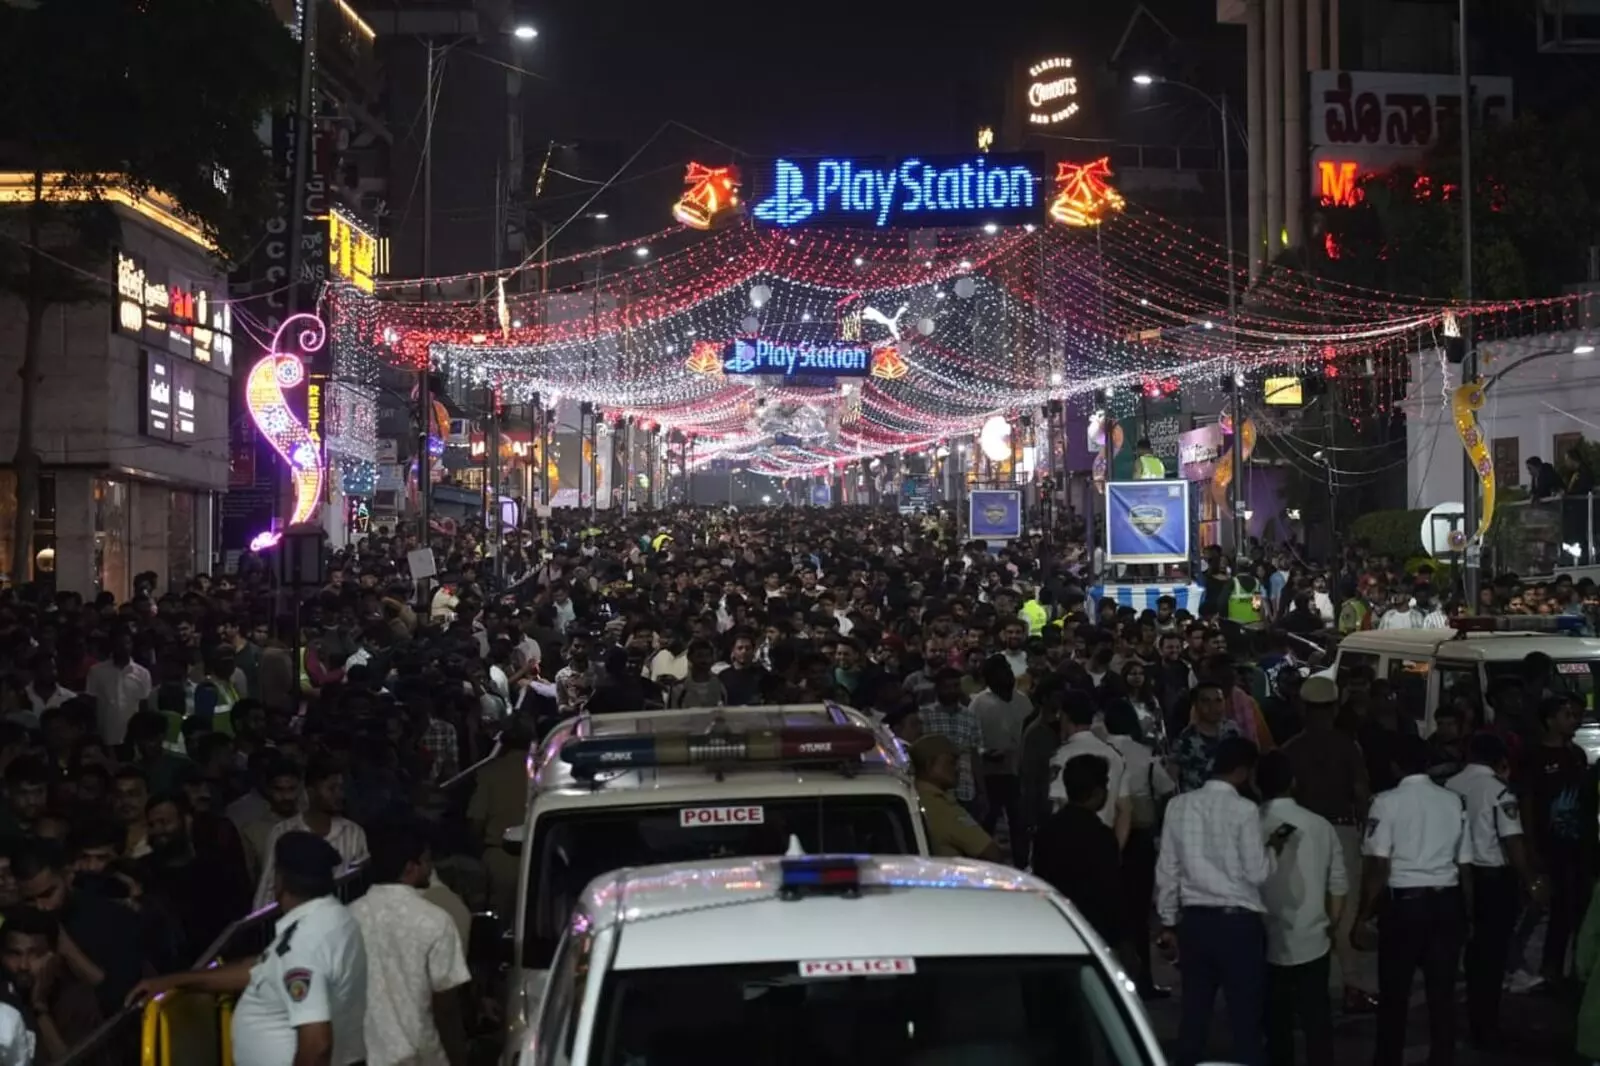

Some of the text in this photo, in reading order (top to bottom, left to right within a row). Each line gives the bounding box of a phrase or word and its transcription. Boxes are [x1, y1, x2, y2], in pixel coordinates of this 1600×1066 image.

[1029, 57, 1073, 77] CLASSIC
[817, 158, 1035, 227] PlayStation
[756, 339, 867, 374] PlayStation
[684, 808, 761, 823] POLICE
[805, 960, 908, 975] POLICE
